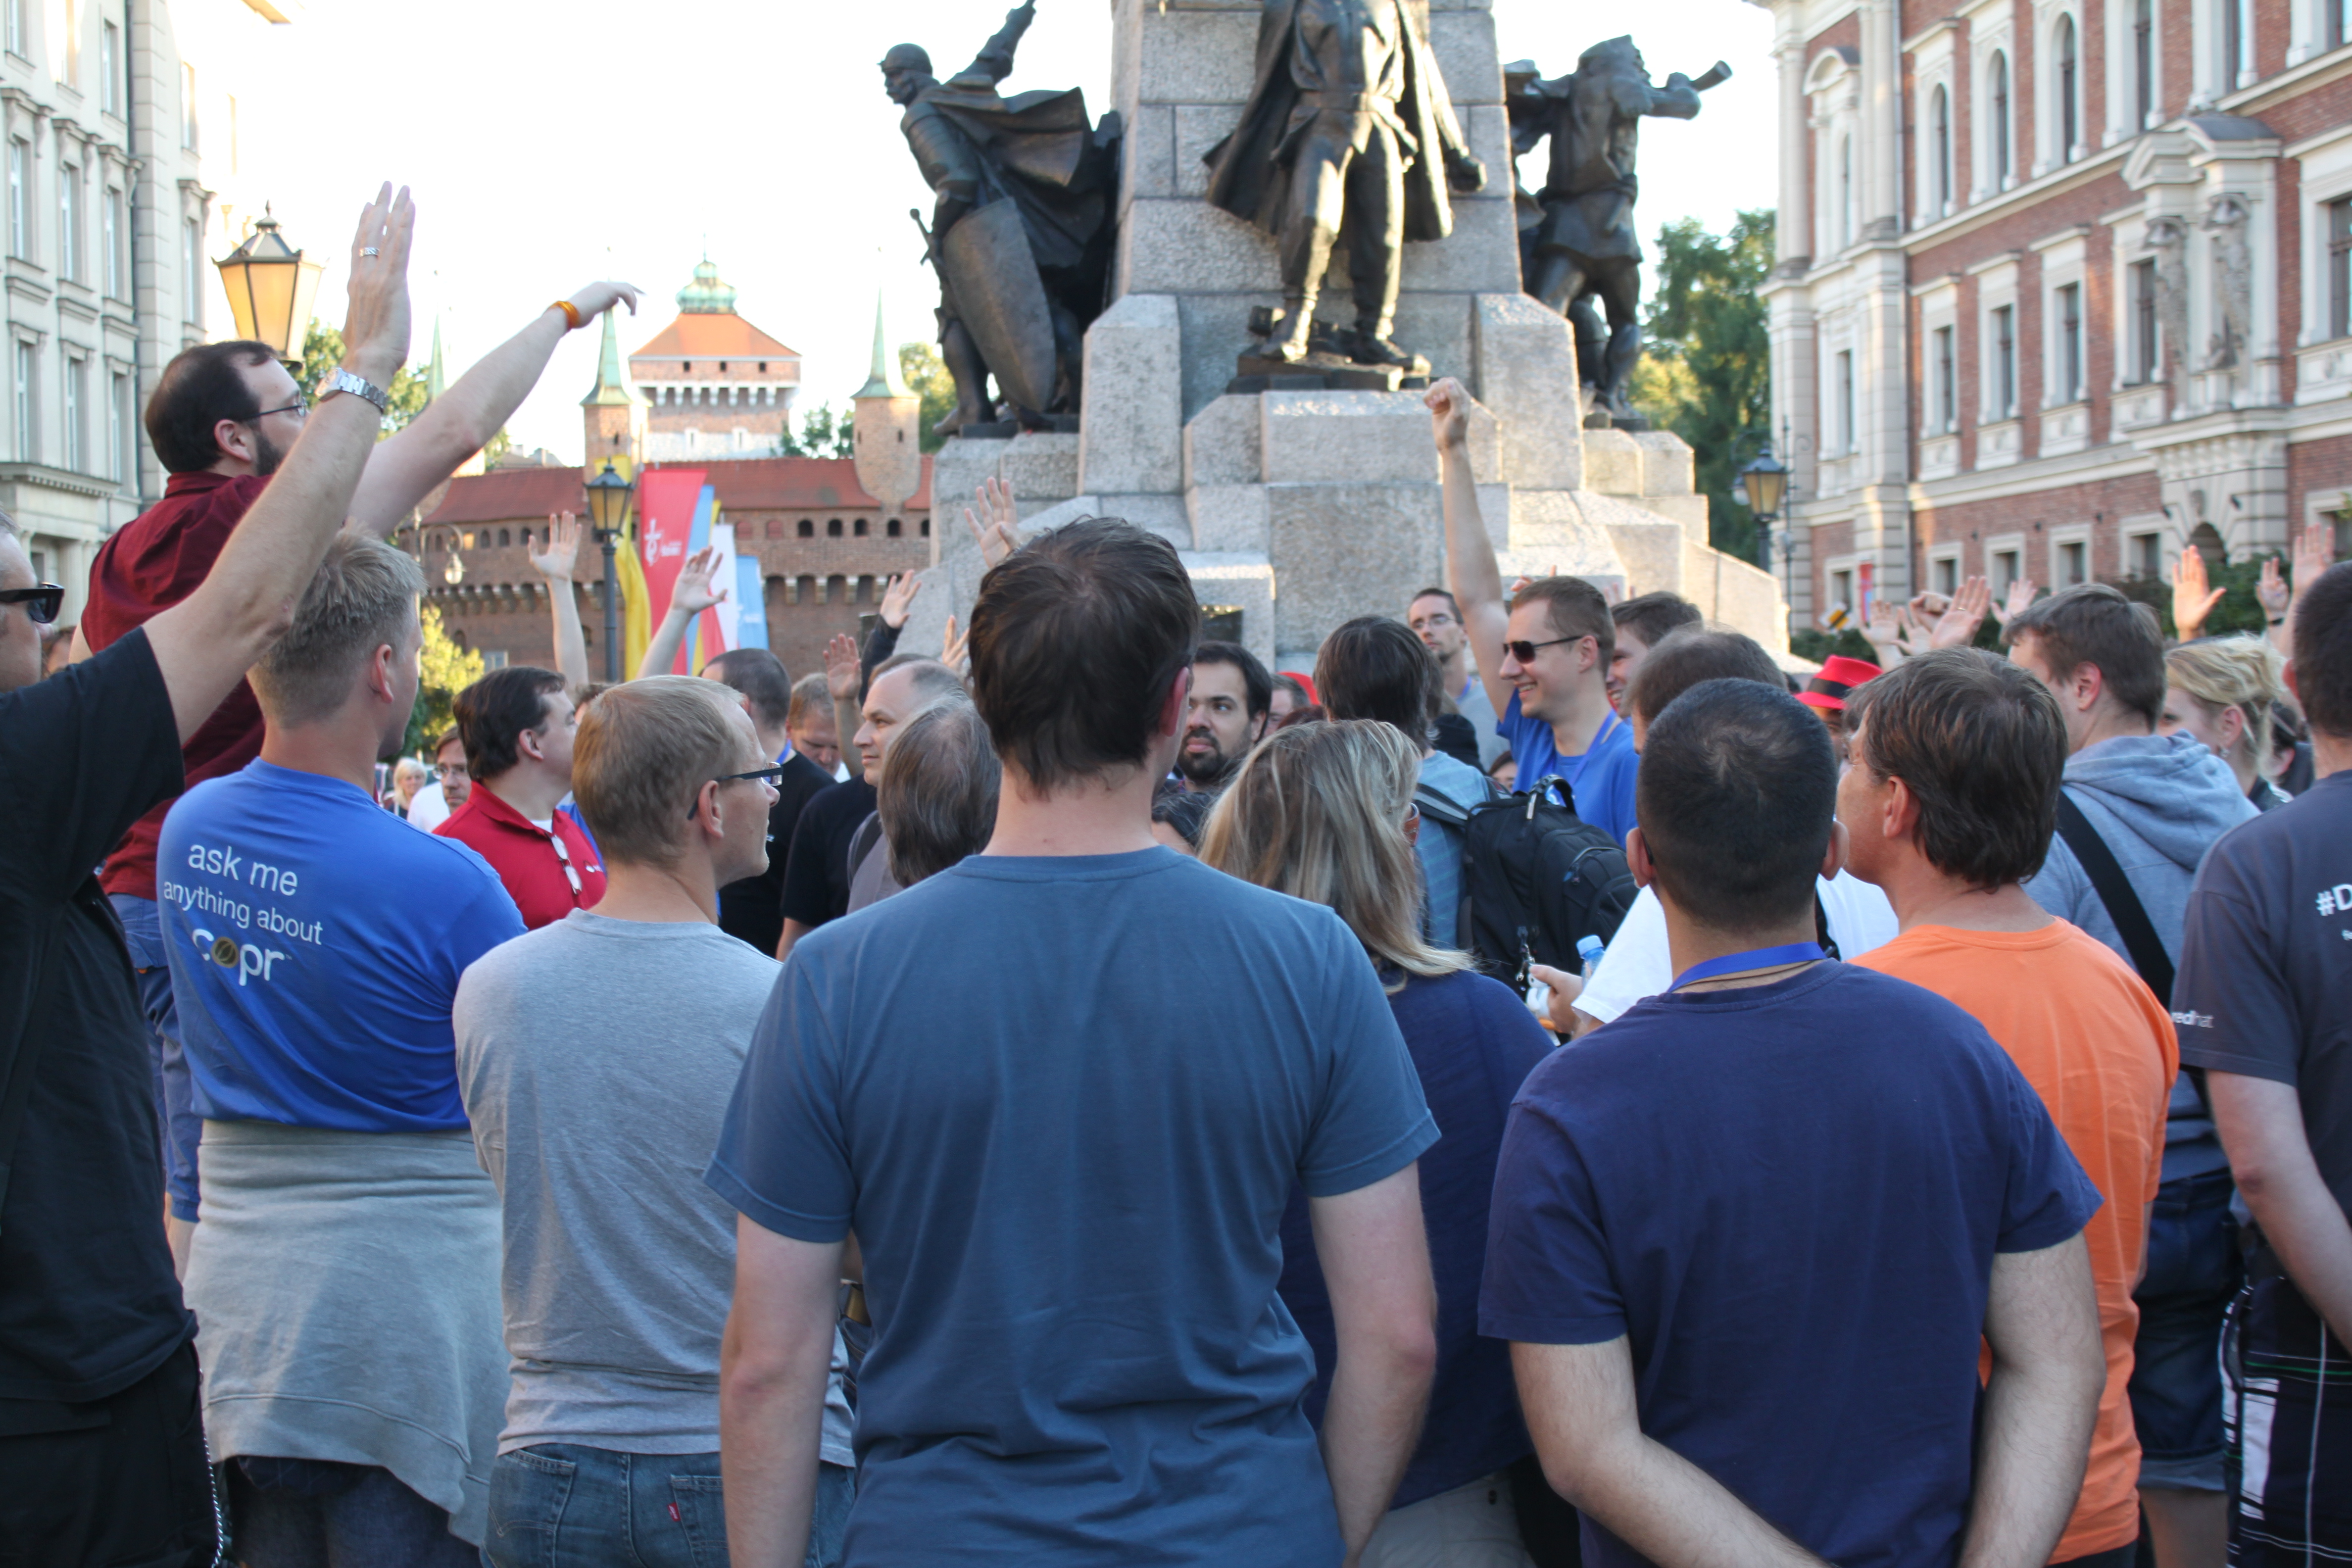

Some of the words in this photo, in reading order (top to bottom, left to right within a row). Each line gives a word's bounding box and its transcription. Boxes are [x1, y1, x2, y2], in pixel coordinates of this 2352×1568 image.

[188, 845, 241, 881] ask
[250, 862, 298, 896] me
[164, 881, 250, 929] anything
[257, 907, 323, 945] about
